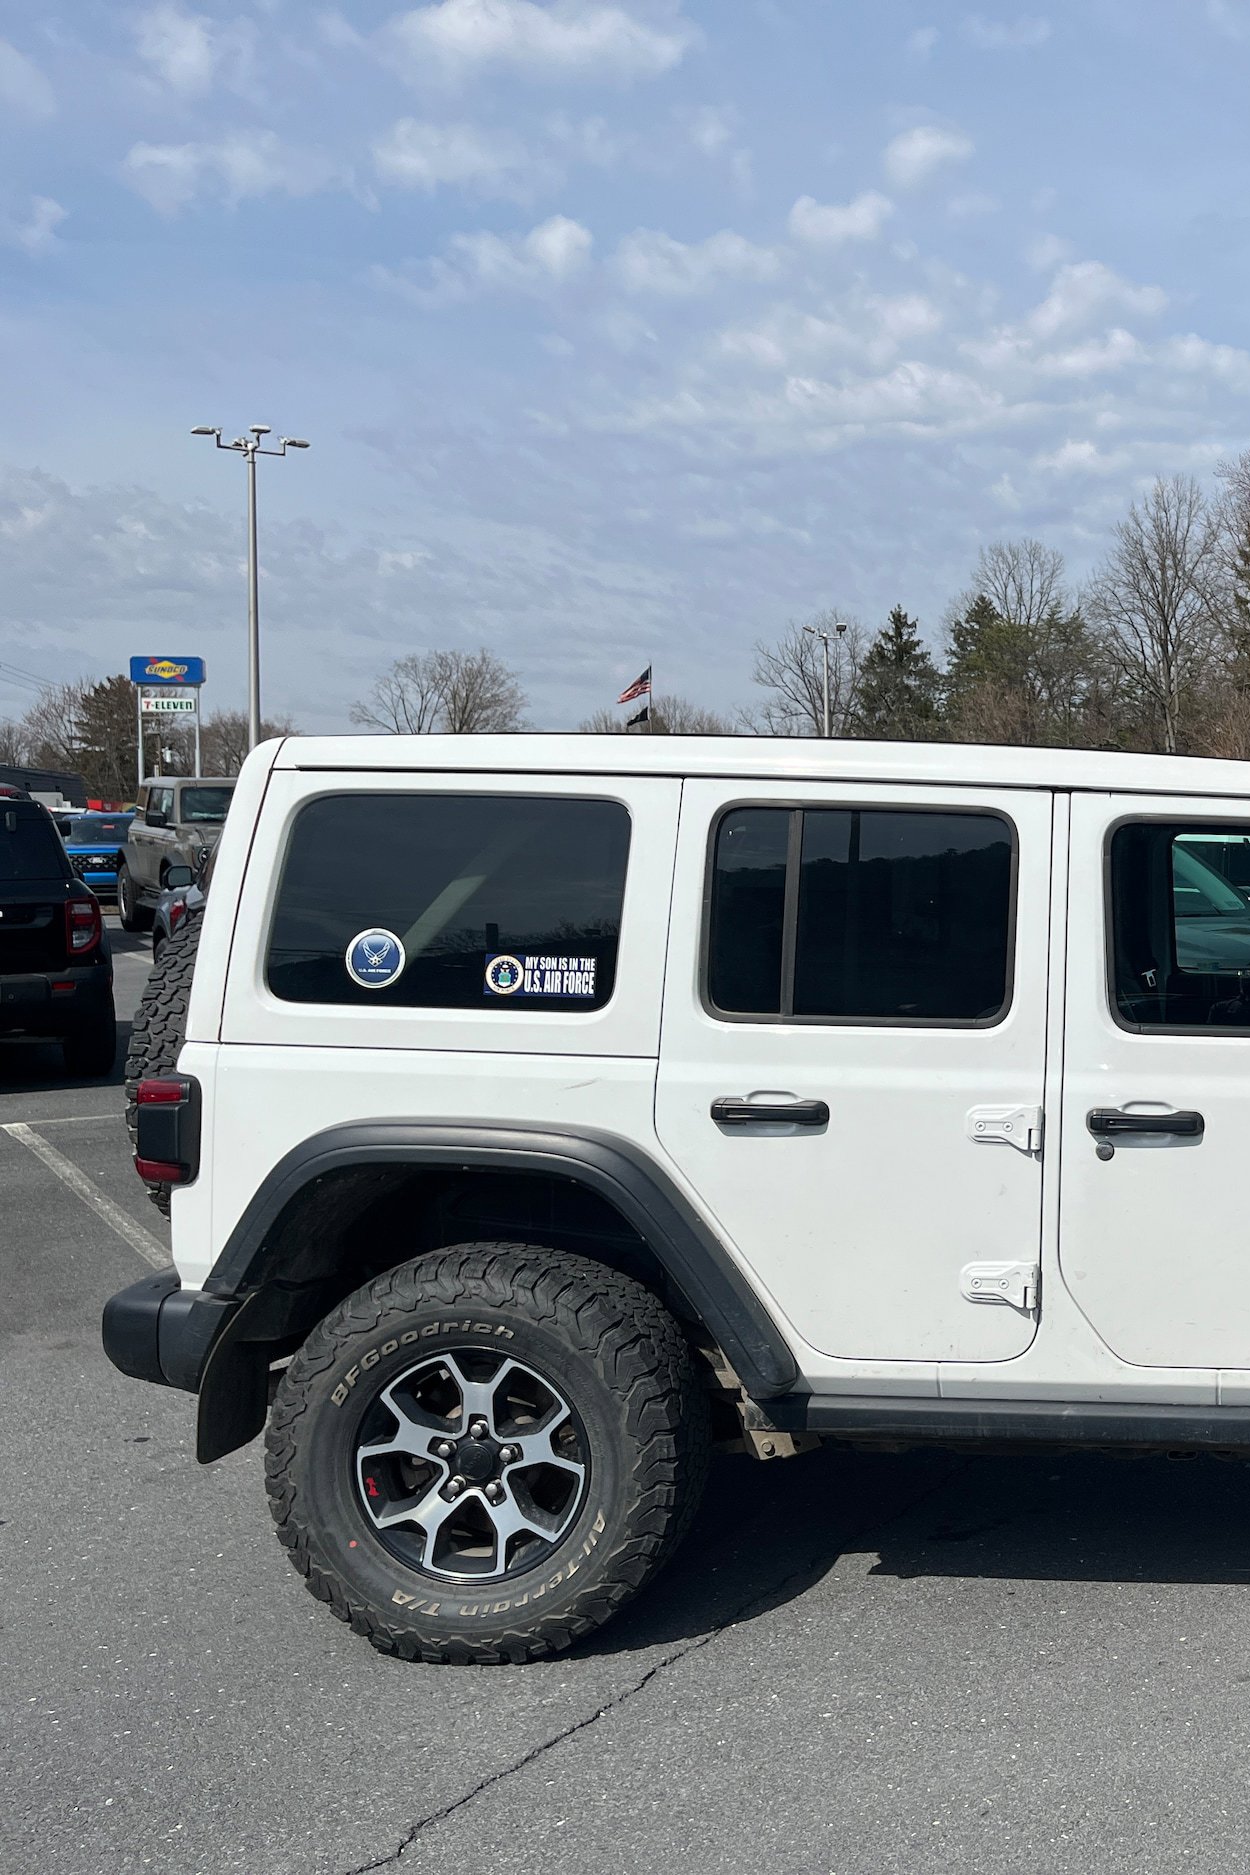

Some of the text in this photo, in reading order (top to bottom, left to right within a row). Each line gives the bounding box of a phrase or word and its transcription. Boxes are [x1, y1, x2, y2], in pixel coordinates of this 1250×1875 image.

[147, 665, 187, 674] SUNOCO
[525, 956, 539, 970] MY
[539, 956, 557, 971] SON
[558, 957, 568, 971] IS
[569, 957, 578, 971] IN
[580, 957, 596, 972] THE
[523, 970, 595, 995] U.S. AIR FORCE
[330, 1319, 516, 1408] BFGoodrich
[391, 1589, 441, 1617] T/A
